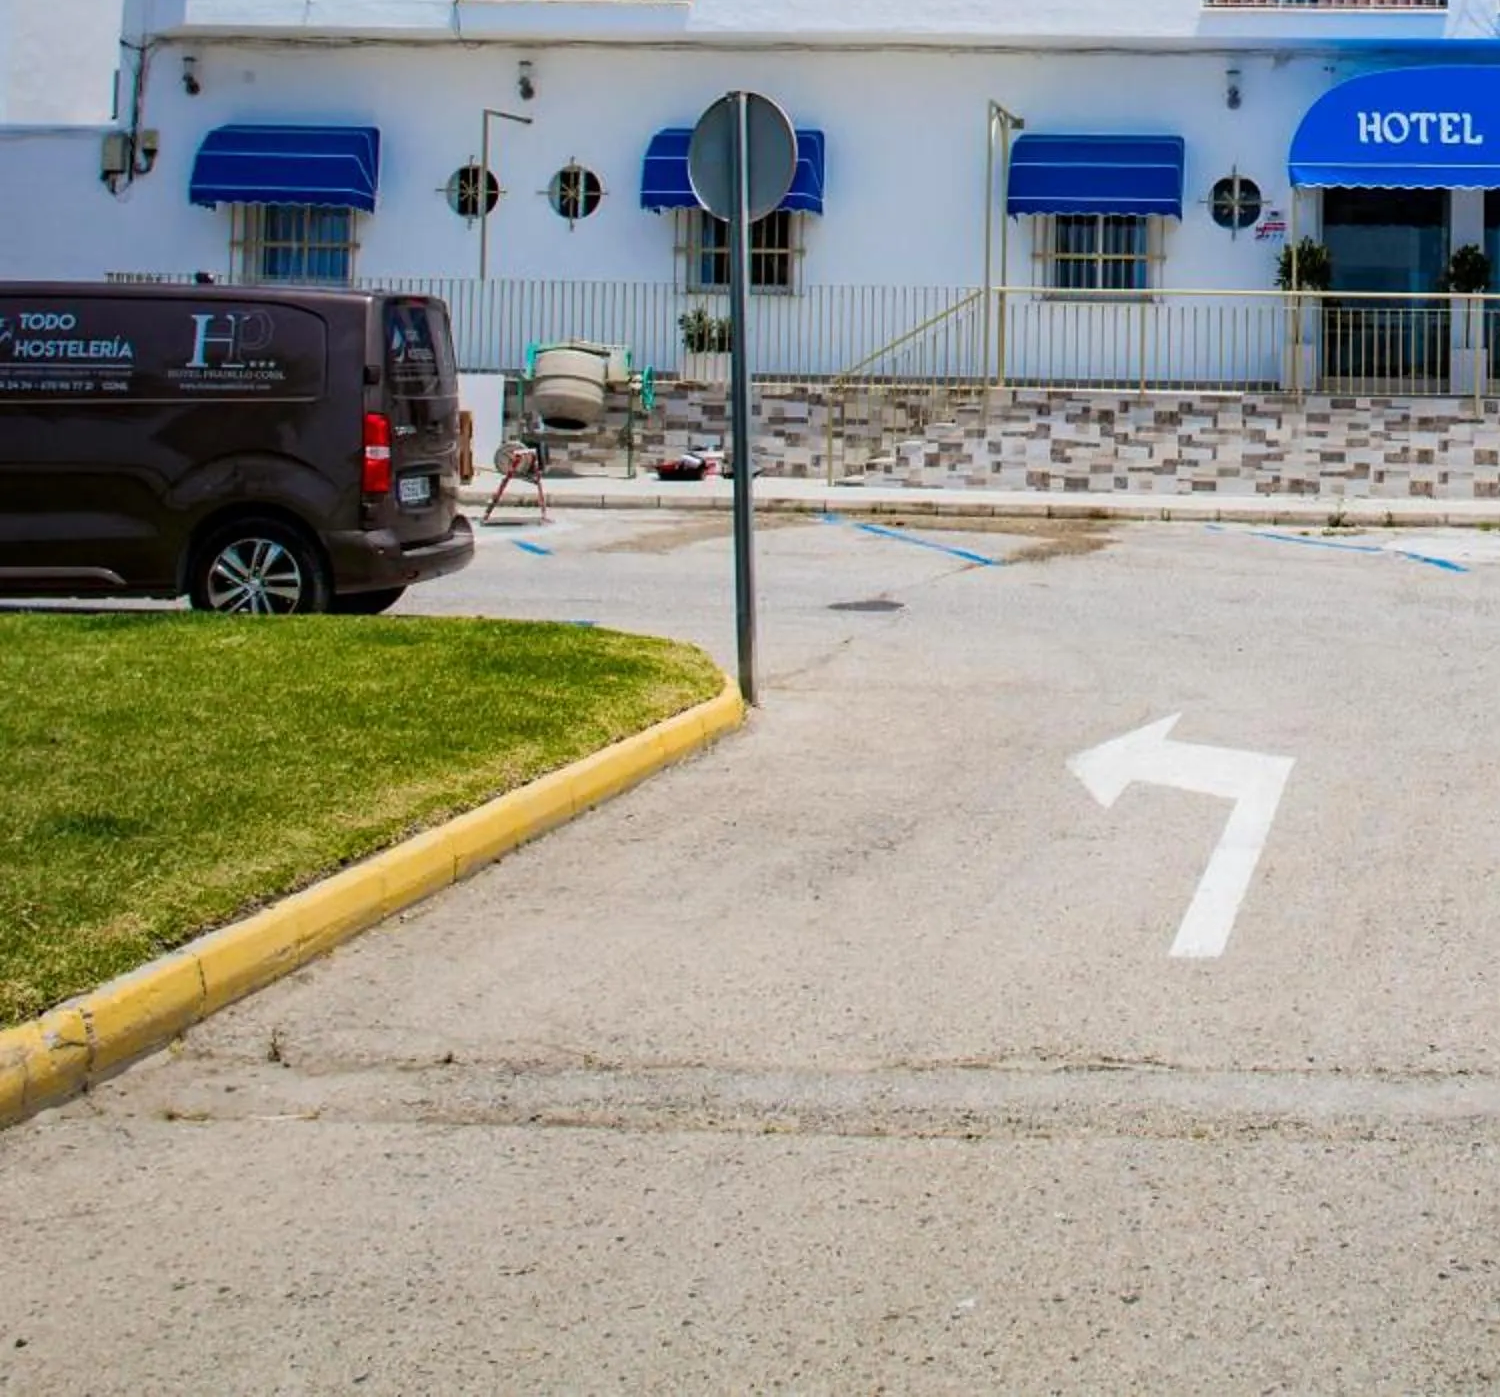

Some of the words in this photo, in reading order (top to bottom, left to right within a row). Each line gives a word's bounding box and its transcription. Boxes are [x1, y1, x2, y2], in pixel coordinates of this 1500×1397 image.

[1357, 112, 1483, 145] HOTEL
[19, 313, 76, 330] TODO
[13, 334, 133, 358] HOSTELERÍA
